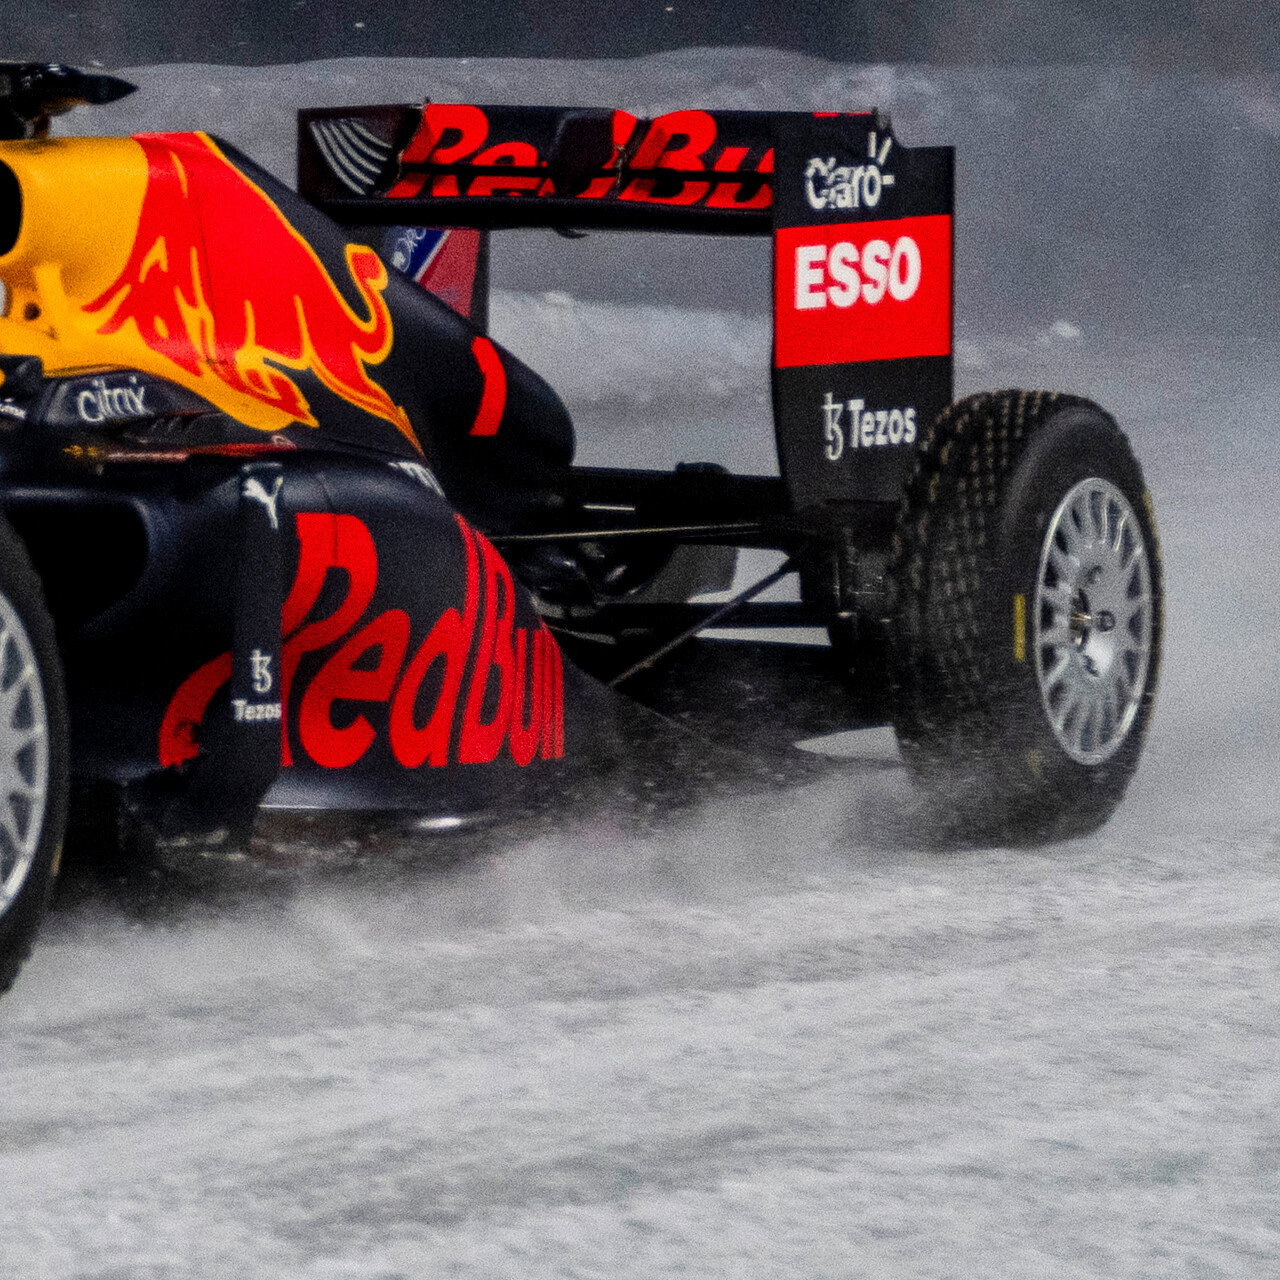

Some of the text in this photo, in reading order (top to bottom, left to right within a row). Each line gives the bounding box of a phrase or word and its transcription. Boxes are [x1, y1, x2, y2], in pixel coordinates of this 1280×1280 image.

[794, 236, 921, 309] ESSO
[77, 375, 153, 423] citrix
[849, 398, 917, 448] Tezos
[232, 700, 282, 722] Tezos
